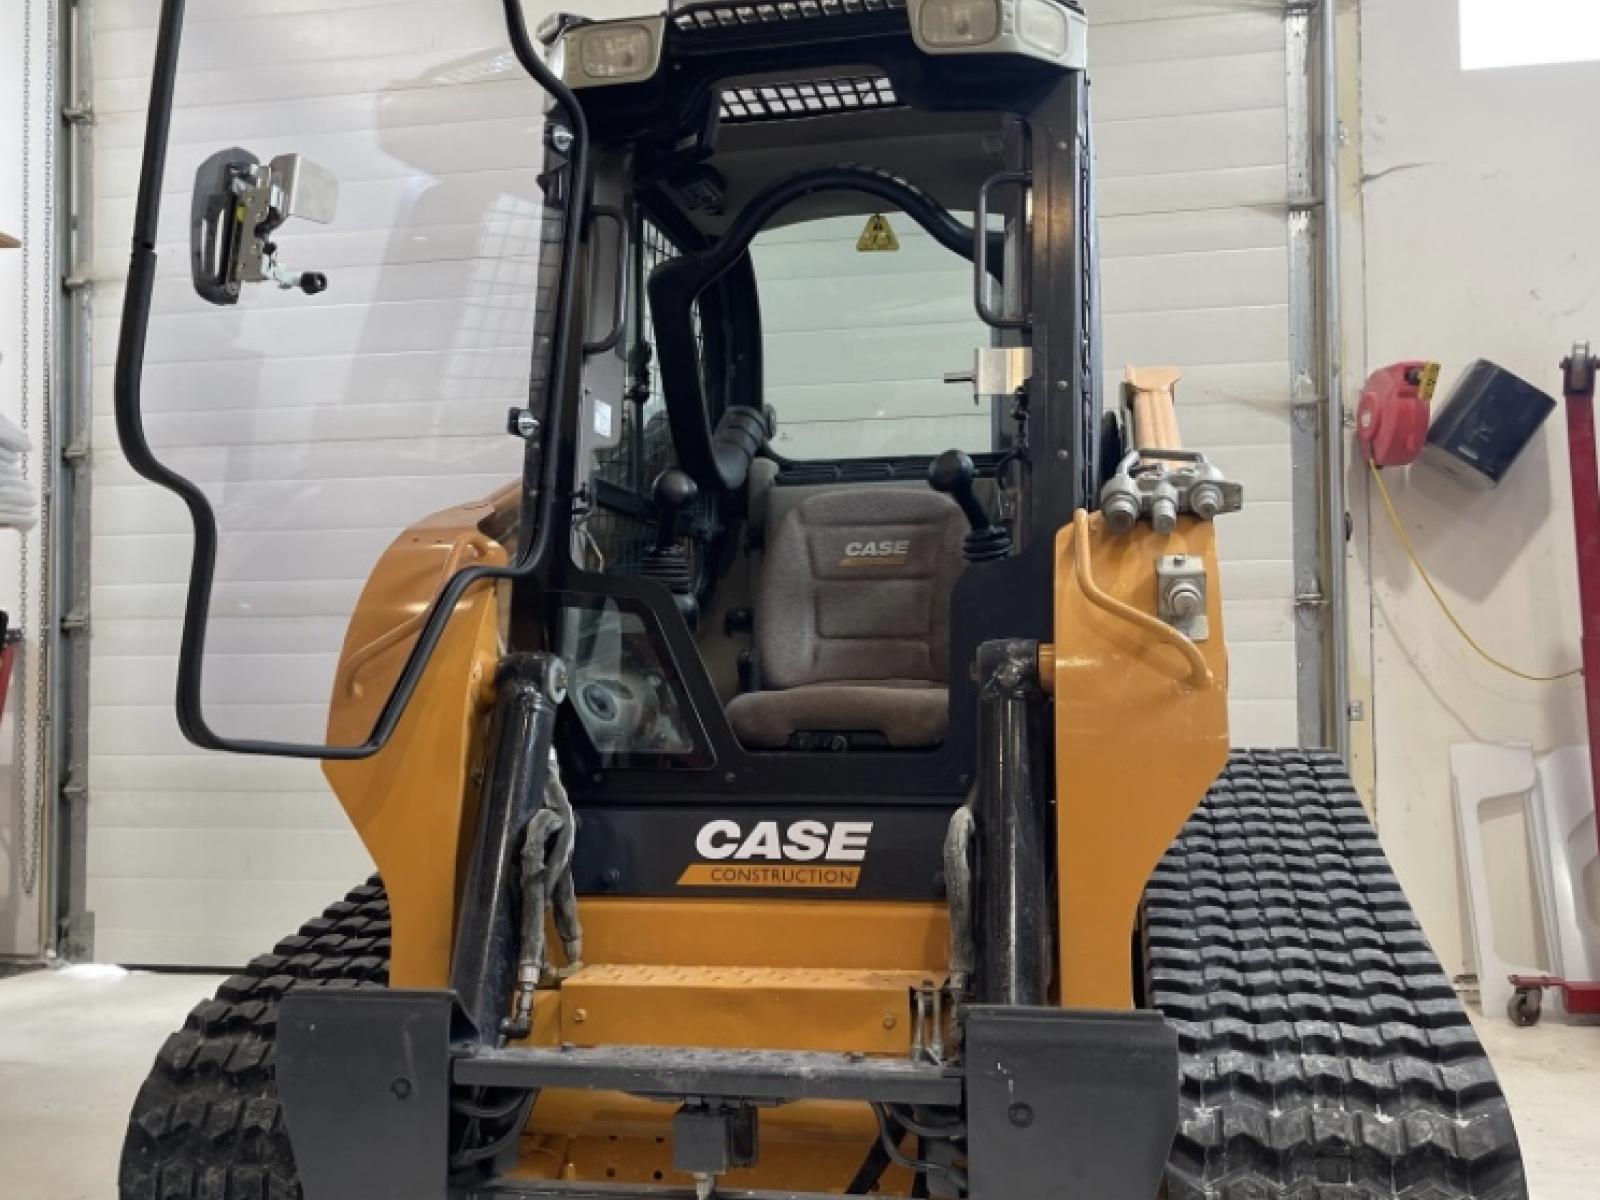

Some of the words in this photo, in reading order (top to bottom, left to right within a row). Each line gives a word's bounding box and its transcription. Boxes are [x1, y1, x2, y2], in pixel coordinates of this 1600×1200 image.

[845, 540, 910, 556] CASE
[696, 820, 873, 861] CASE
[711, 868, 853, 884] CONSTRUCTION
